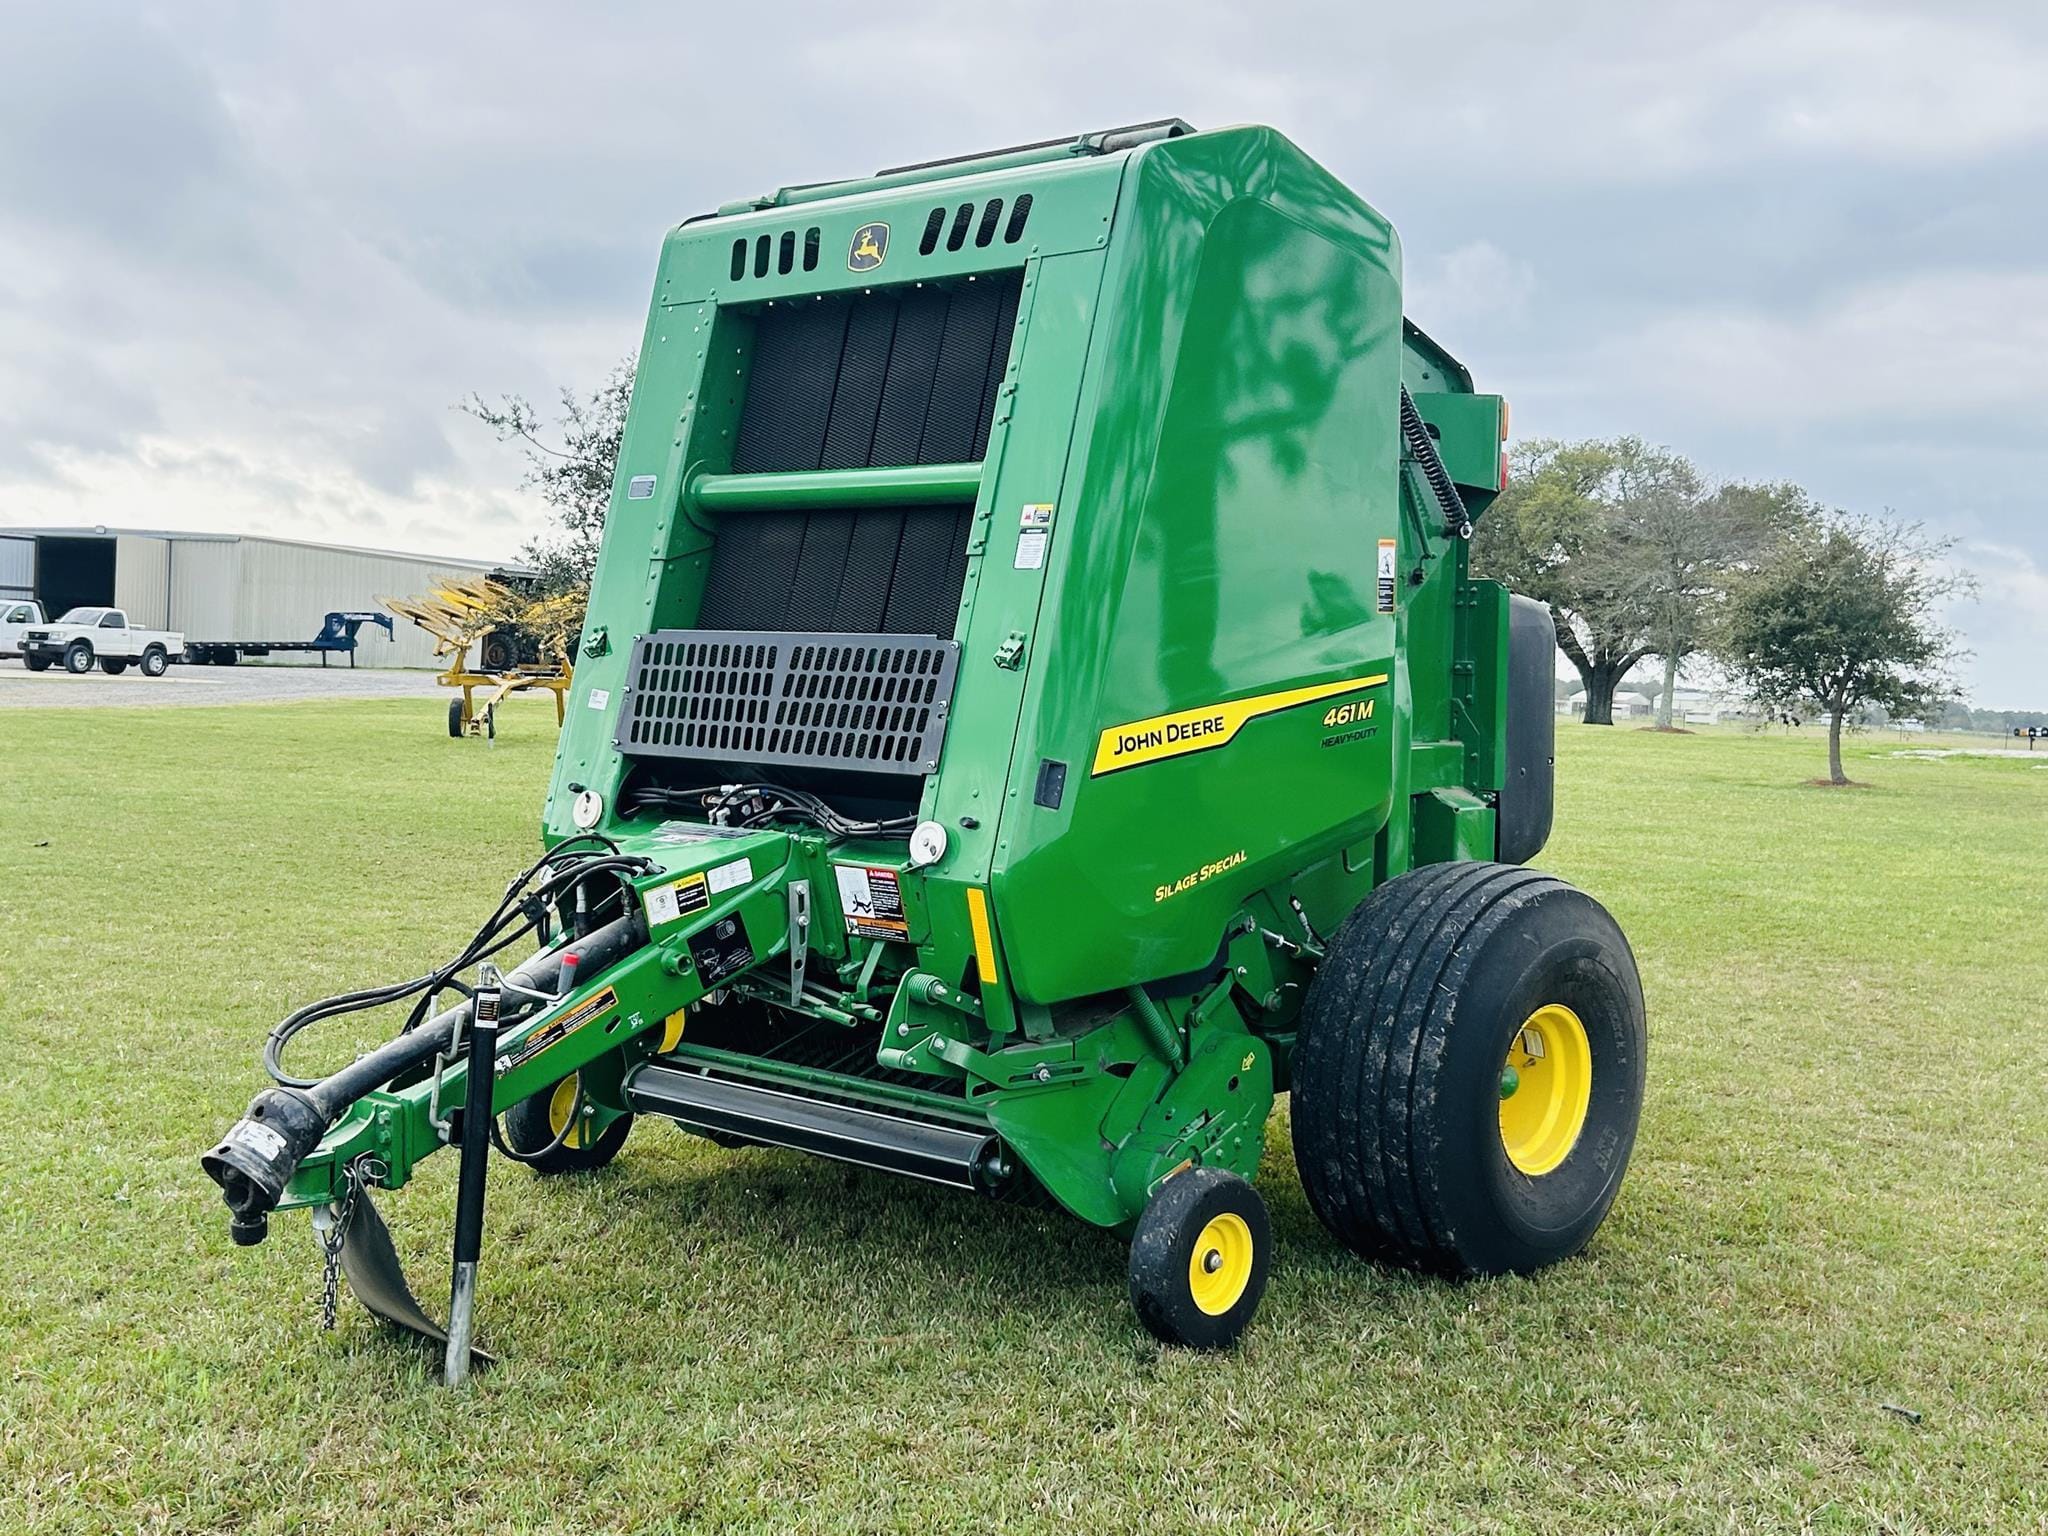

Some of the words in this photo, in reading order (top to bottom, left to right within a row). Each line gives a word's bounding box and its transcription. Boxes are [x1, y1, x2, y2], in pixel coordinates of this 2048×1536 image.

[1114, 729, 1162, 756] JOHN
[1166, 716, 1225, 743] DEERE
[1321, 727, 1378, 748] HEAVY-DUTY
[1155, 872, 1198, 902] SILAGE
[1199, 850, 1248, 881] SPECIAL
